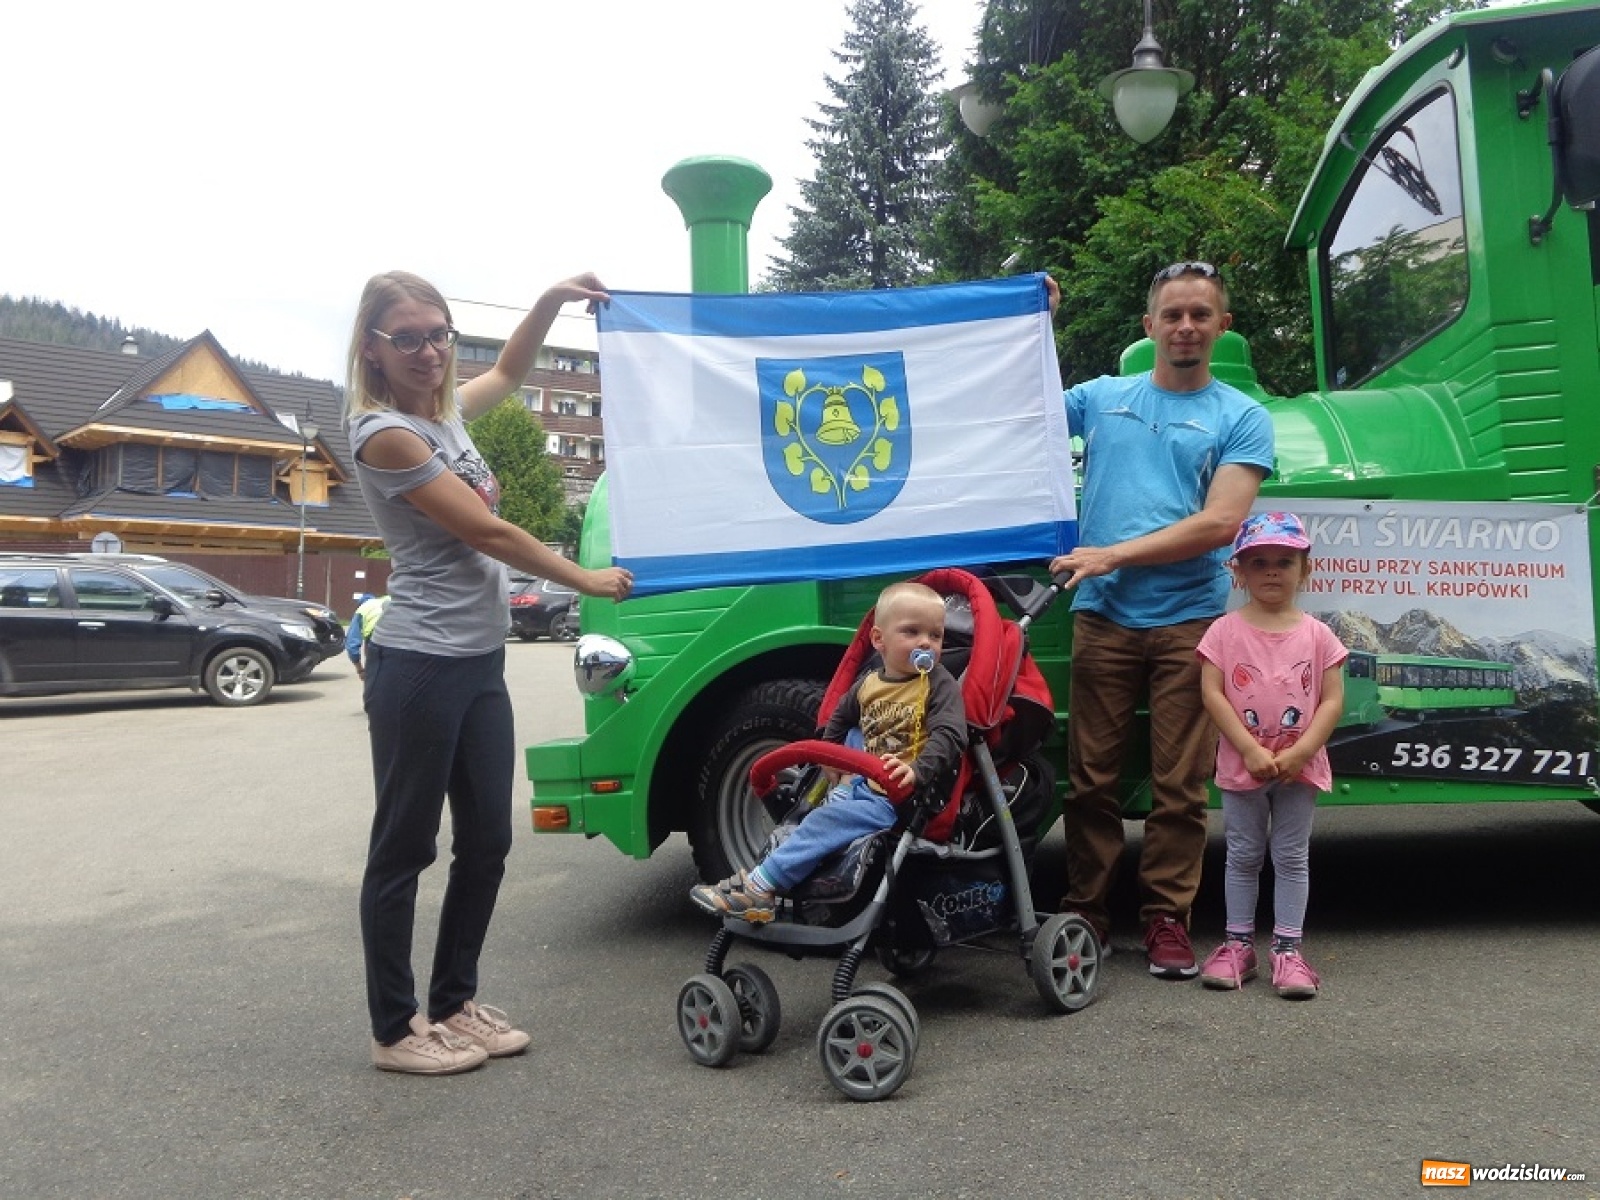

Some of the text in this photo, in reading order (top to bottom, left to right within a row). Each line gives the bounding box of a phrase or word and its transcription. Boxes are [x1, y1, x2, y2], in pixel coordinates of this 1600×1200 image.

[1373, 509, 1560, 551] ŚWARNO
[1377, 560, 1421, 574] PRZY
[1428, 561, 1564, 578] SANKTUARIUM
[1341, 579, 1387, 594] PRZY
[1393, 581, 1421, 595] UL.
[1427, 579, 1528, 598] KRUPÓWKI
[1391, 742, 1590, 776] 536 327 721
